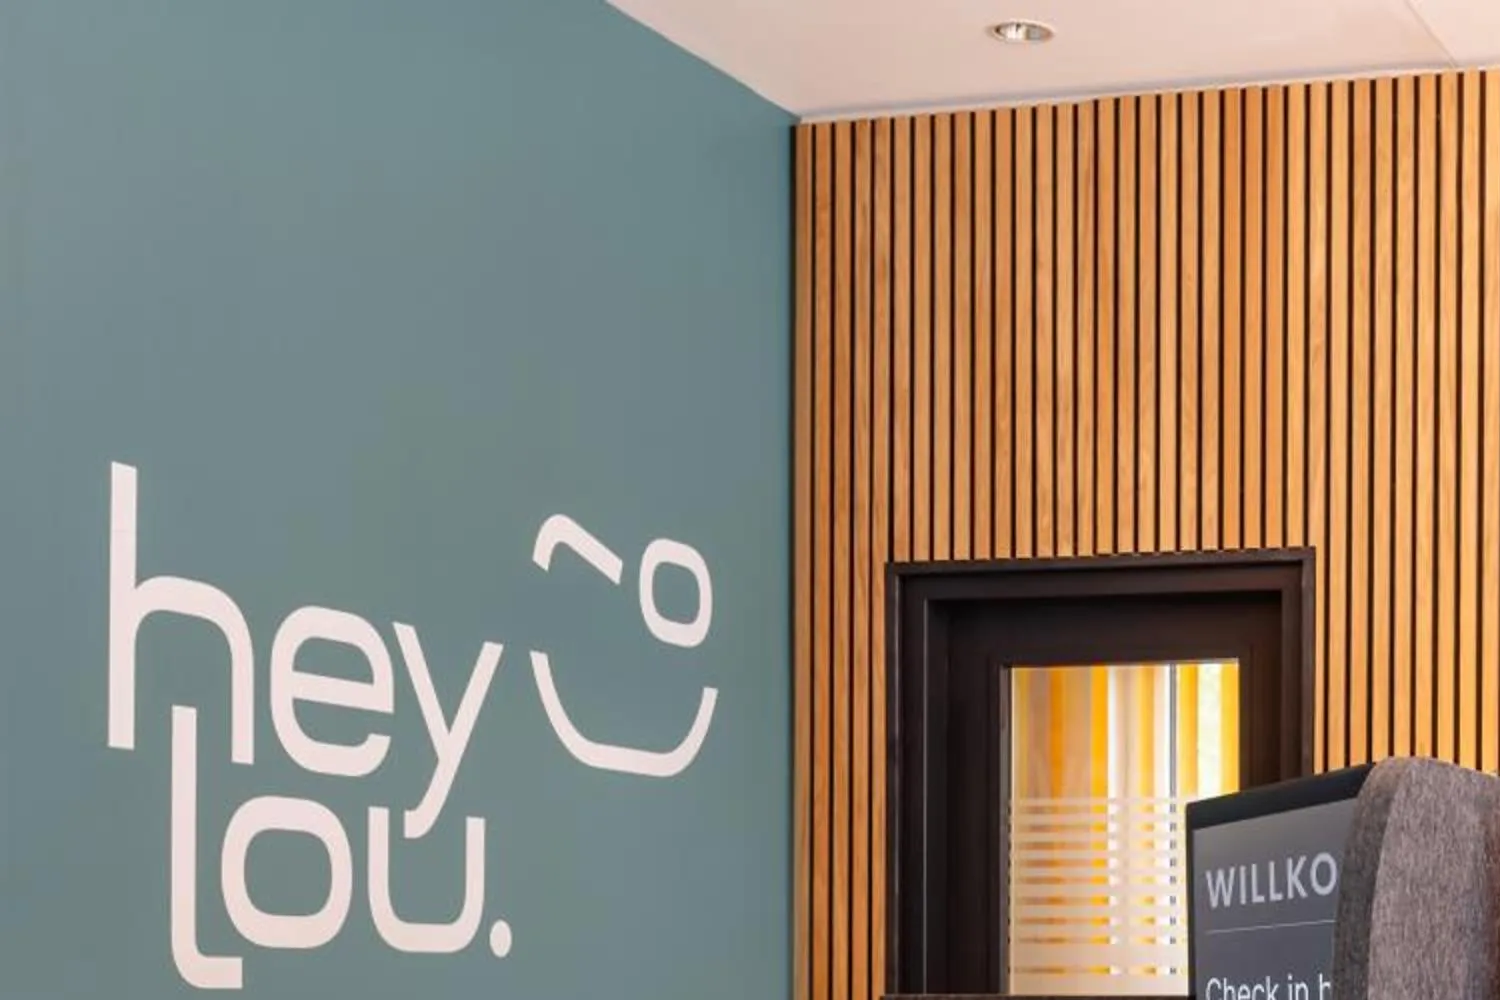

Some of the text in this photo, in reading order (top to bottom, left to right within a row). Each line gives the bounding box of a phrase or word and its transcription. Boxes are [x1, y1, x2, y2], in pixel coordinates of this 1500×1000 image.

[109, 461, 503, 839] hey
[171, 704, 512, 989] lou.
[1205, 852, 1338, 909] WILLKO
